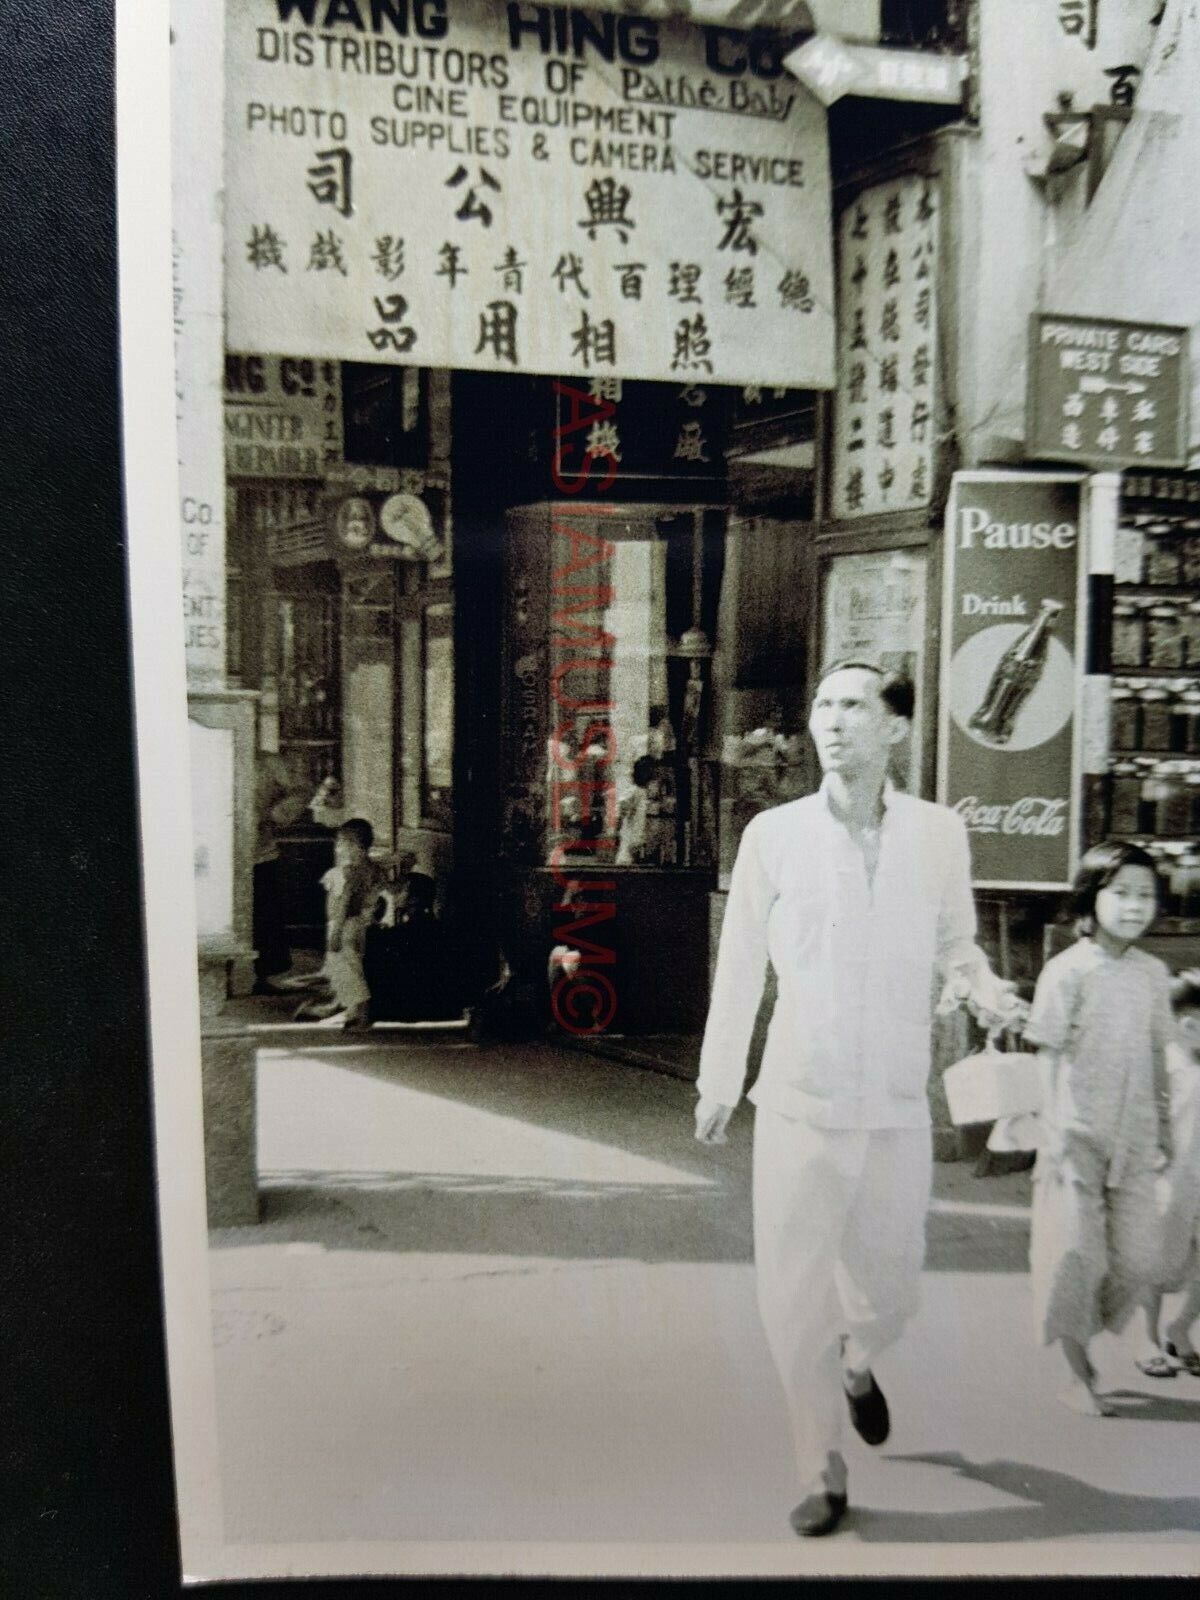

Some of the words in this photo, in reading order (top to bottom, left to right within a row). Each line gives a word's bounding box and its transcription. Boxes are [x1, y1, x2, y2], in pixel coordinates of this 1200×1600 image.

[257, 27, 509, 89] DISTRIBUTORS
[545, 59, 586, 94] OF
[507, 3, 660, 65] HING
[393, 83, 469, 118] CINE
[500, 95, 677, 140] EQUIPMENT
[247, 102, 348, 141] PHOTO
[370, 116, 510, 159] SUPPLIES
[532, 133, 549, 161] &
[570, 137, 678, 174] CAMERA
[693, 150, 806, 187] SERVICE
[1041, 324, 1120, 350] PRIVATE
[1126, 331, 1181, 356] CARS
[960, 507, 1076, 551] Pause
[961, 594, 1027, 617] Drink
